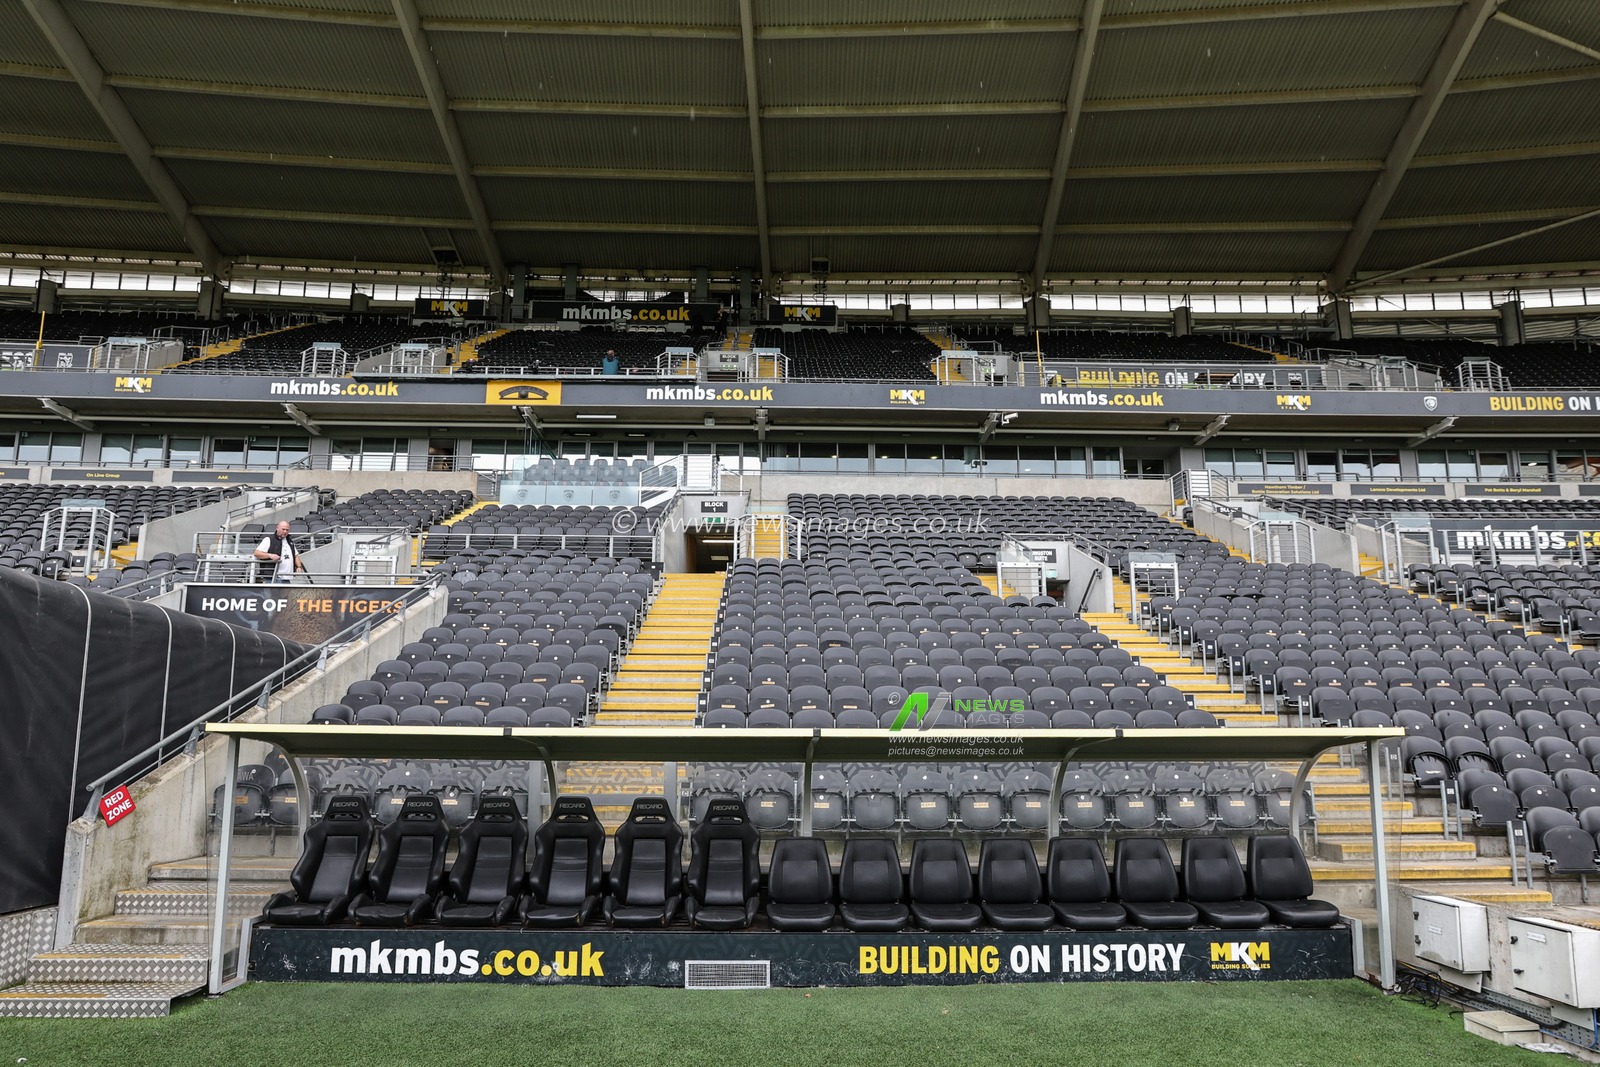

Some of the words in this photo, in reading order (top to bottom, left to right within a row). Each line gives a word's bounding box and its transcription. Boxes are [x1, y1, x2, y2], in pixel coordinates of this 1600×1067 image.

[431, 300, 468, 316] MKM
[562, 304, 690, 321] mkmbs.co.uk
[784, 306, 821, 321] MKM
[115, 376, 153, 393] MKM
[270, 379, 399, 396] mkmbs.co.uk
[1164, 372, 1188, 388] ON
[646, 384, 774, 401] mkmbs.co.uk
[890, 389, 925, 405] MKM
[1040, 390, 1164, 407] mkmbs.co.uk
[1276, 395, 1311, 410] MKM
[1490, 396, 1564, 411] BUILDING
[1568, 396, 1592, 411] ON
[202, 597, 258, 612] HOME
[262, 598, 288, 612] OF
[297, 599, 333, 613] THE
[338, 599, 405, 614] TIGERS
[104, 791, 124, 808] RED
[106, 799, 132, 821] ZONE
[330, 939, 604, 977] mkmbs.co.uk
[859, 945, 1000, 974] BUILDING
[1010, 945, 1051, 973] ON
[1061, 943, 1186, 973] HISTORY
[1210, 942, 1270, 970] MKM
